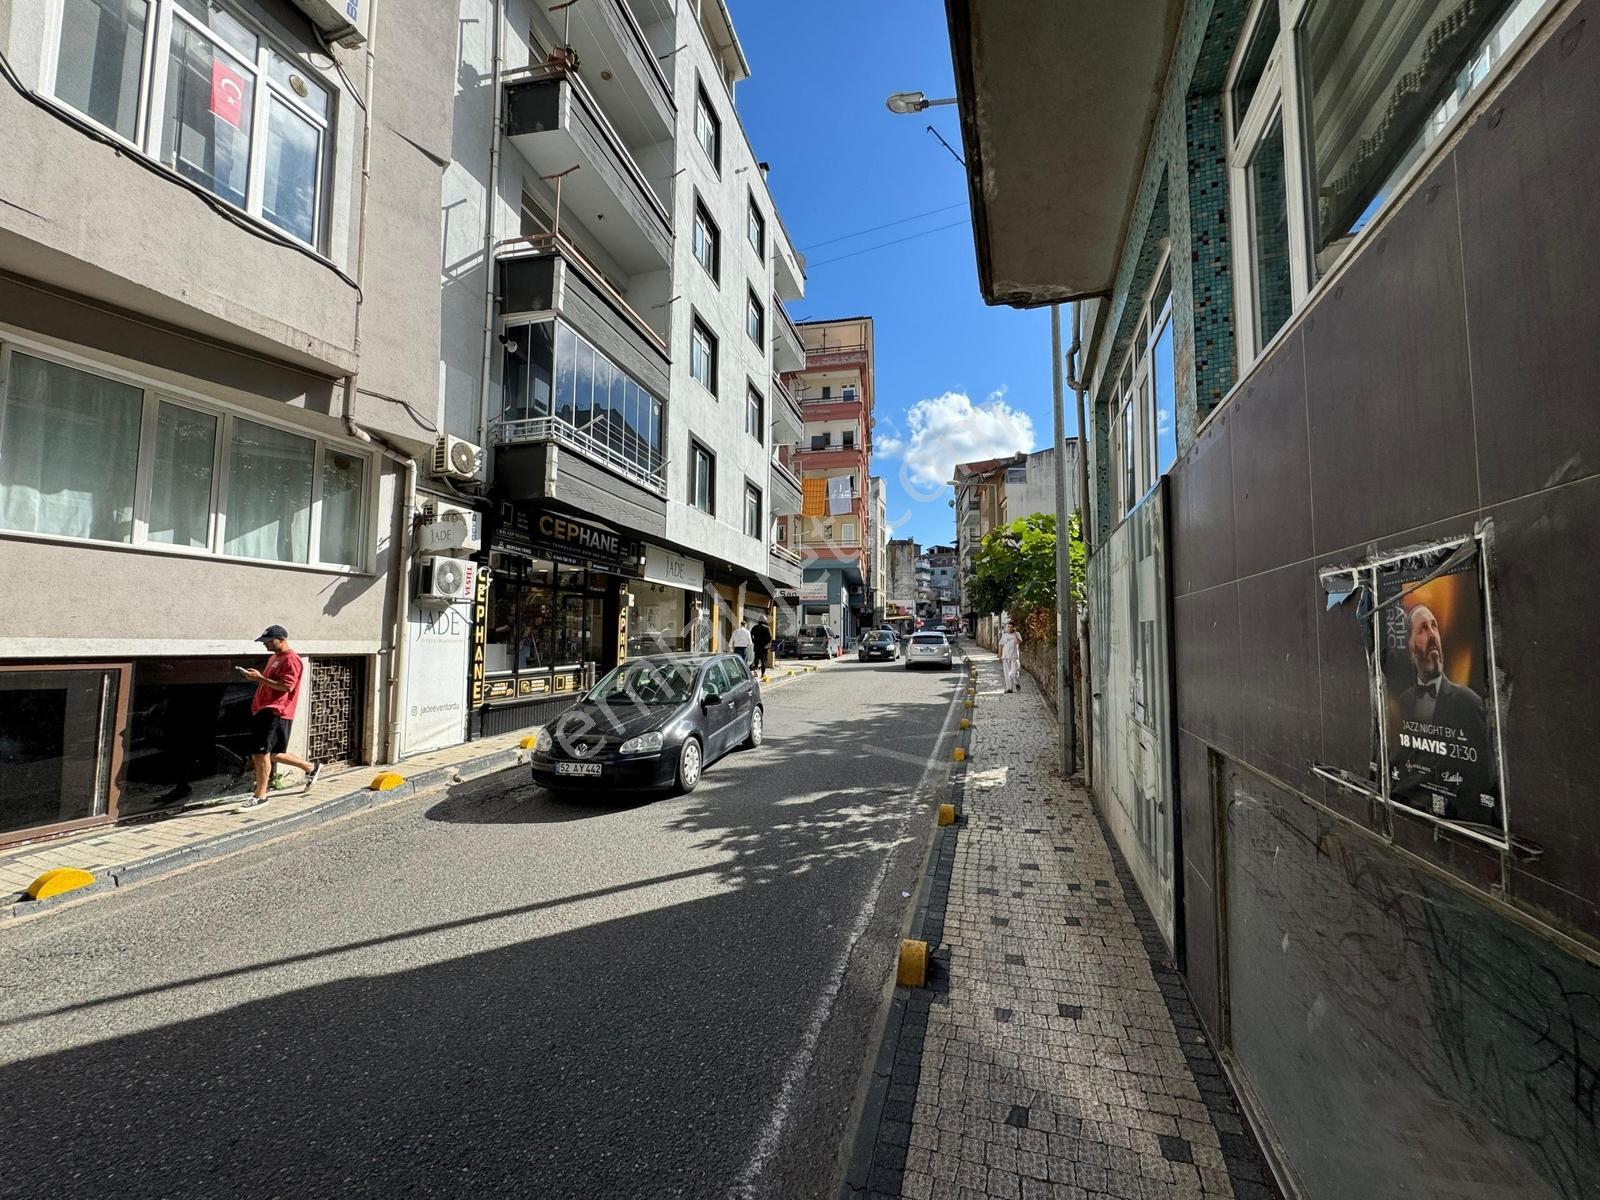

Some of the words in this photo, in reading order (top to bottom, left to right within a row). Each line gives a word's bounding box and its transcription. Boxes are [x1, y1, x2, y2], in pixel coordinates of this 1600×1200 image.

[430, 528, 452, 544] JADE
[540, 515, 619, 554] CEPHANE
[465, 565, 473, 596] VESTEL
[664, 555, 685, 579] JADE
[416, 609, 460, 641] JADE
[1394, 600, 1408, 649] ATİH
[1402, 720, 1419, 732] JAZZ
[1420, 723, 1444, 737] NIGHT
[1445, 727, 1456, 738] BY
[1399, 733, 1411, 748] 18
[1412, 736, 1447, 756] MAYIS
[1449, 743, 1477, 762] 21:30
[560, 763, 570, 772] 52
[573, 764, 584, 773] AY
[586, 765, 601, 774] 442
